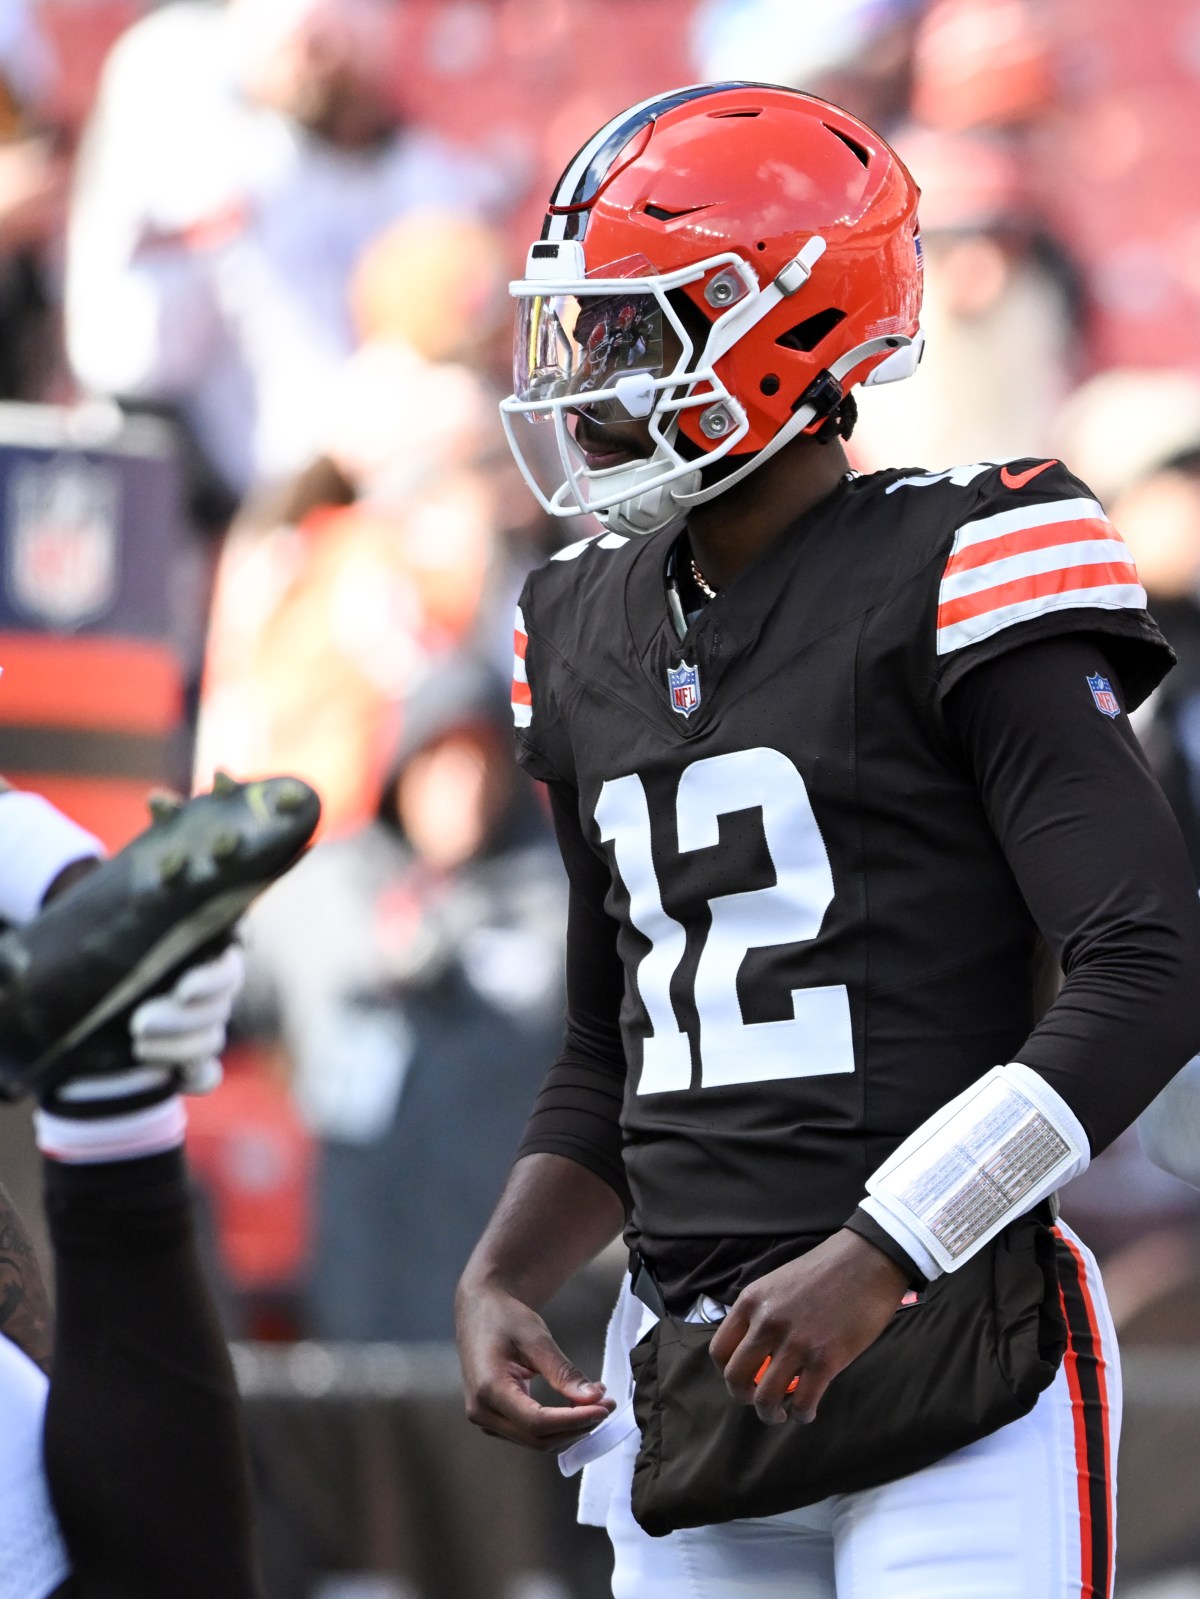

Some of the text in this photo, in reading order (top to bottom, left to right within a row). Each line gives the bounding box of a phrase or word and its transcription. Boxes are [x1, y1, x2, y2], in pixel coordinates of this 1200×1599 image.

[674, 687, 696, 708] NFL
[1096, 692, 1119, 712] NFL
[594, 746, 855, 1096] 12
